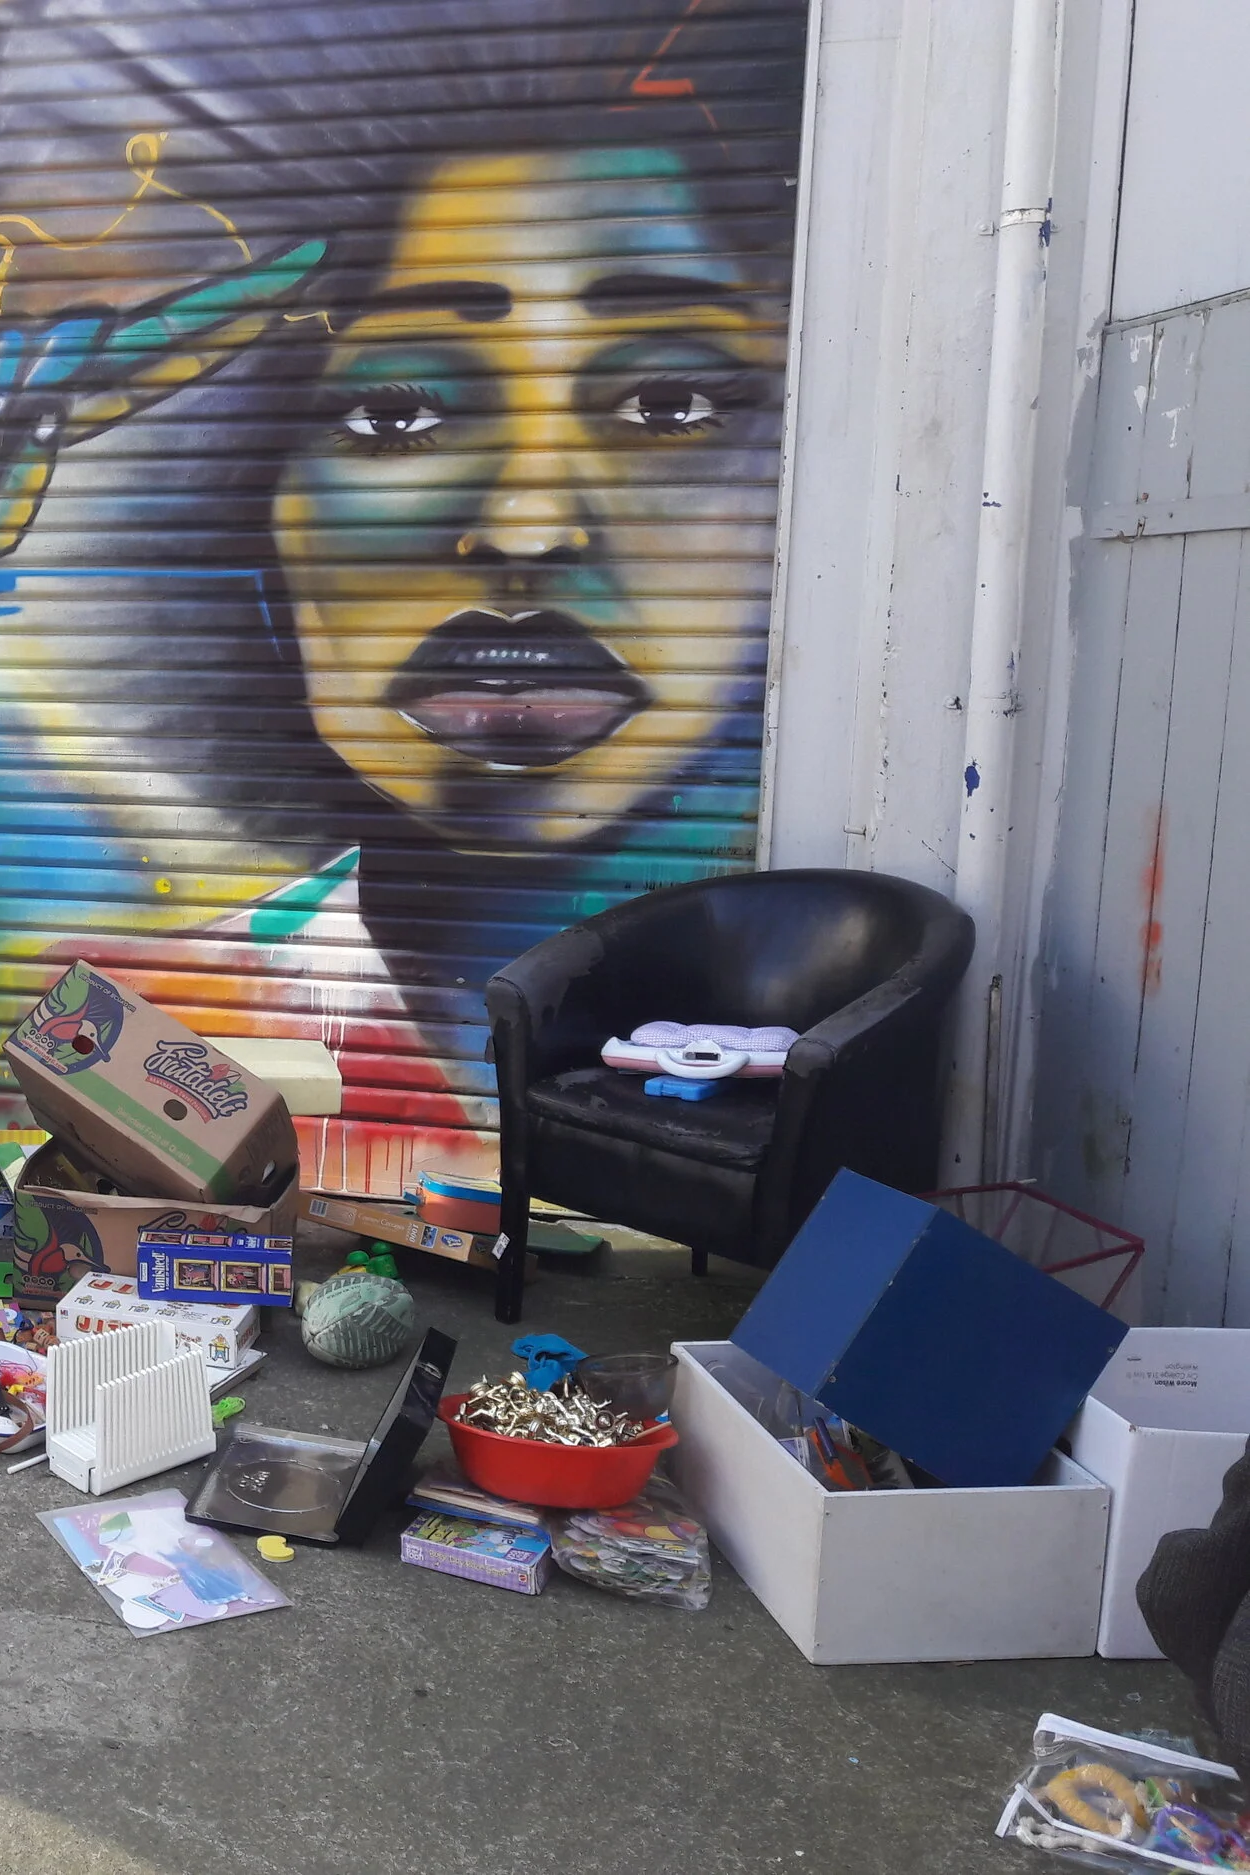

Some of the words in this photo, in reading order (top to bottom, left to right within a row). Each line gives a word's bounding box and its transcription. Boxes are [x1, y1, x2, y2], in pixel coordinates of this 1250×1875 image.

[79, 974, 104, 990] PRODUCT
[144, 1040, 249, 1120] Frutadeli
[151, 1251, 166, 1293] Vanished!
[1154, 1379, 1174, 1387] Wilson
